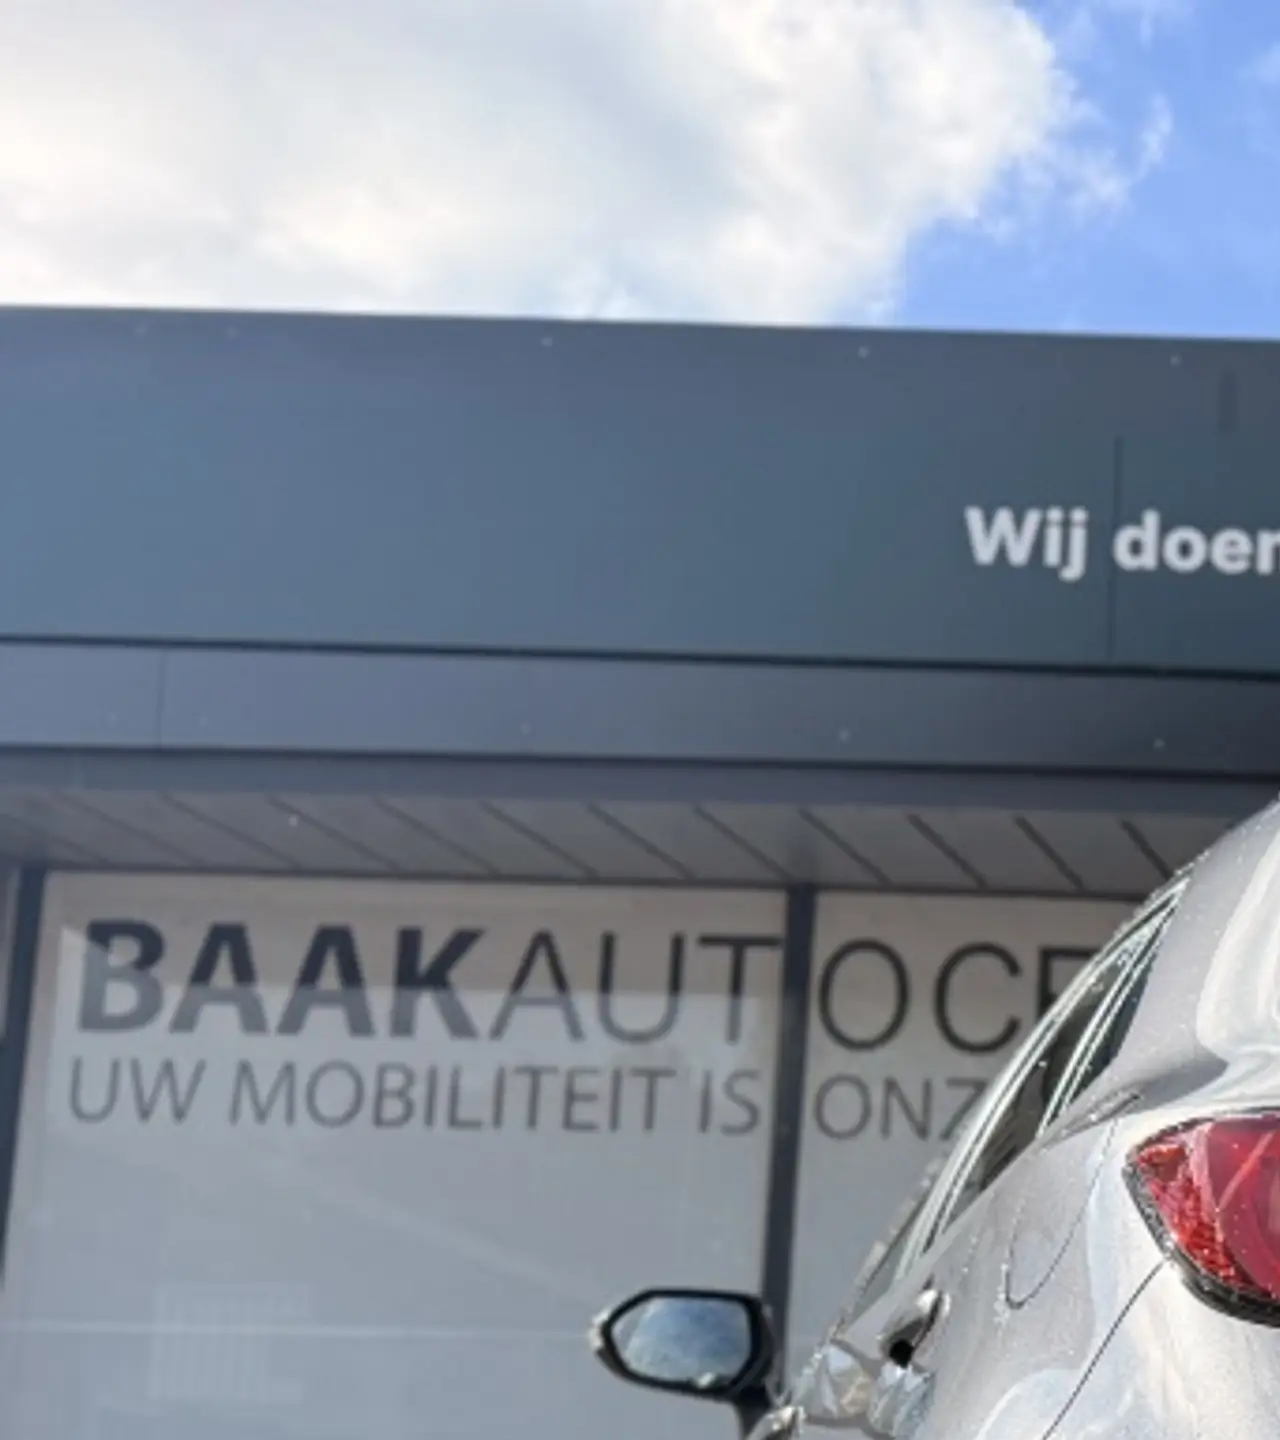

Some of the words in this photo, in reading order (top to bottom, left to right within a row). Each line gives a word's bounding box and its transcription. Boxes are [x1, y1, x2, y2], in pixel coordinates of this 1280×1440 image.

[963, 506, 1089, 581] Wij
[69, 1055, 207, 1125] UW
[227, 1058, 678, 1133] MOBILITEIT
[697, 1069, 762, 1136] IS
